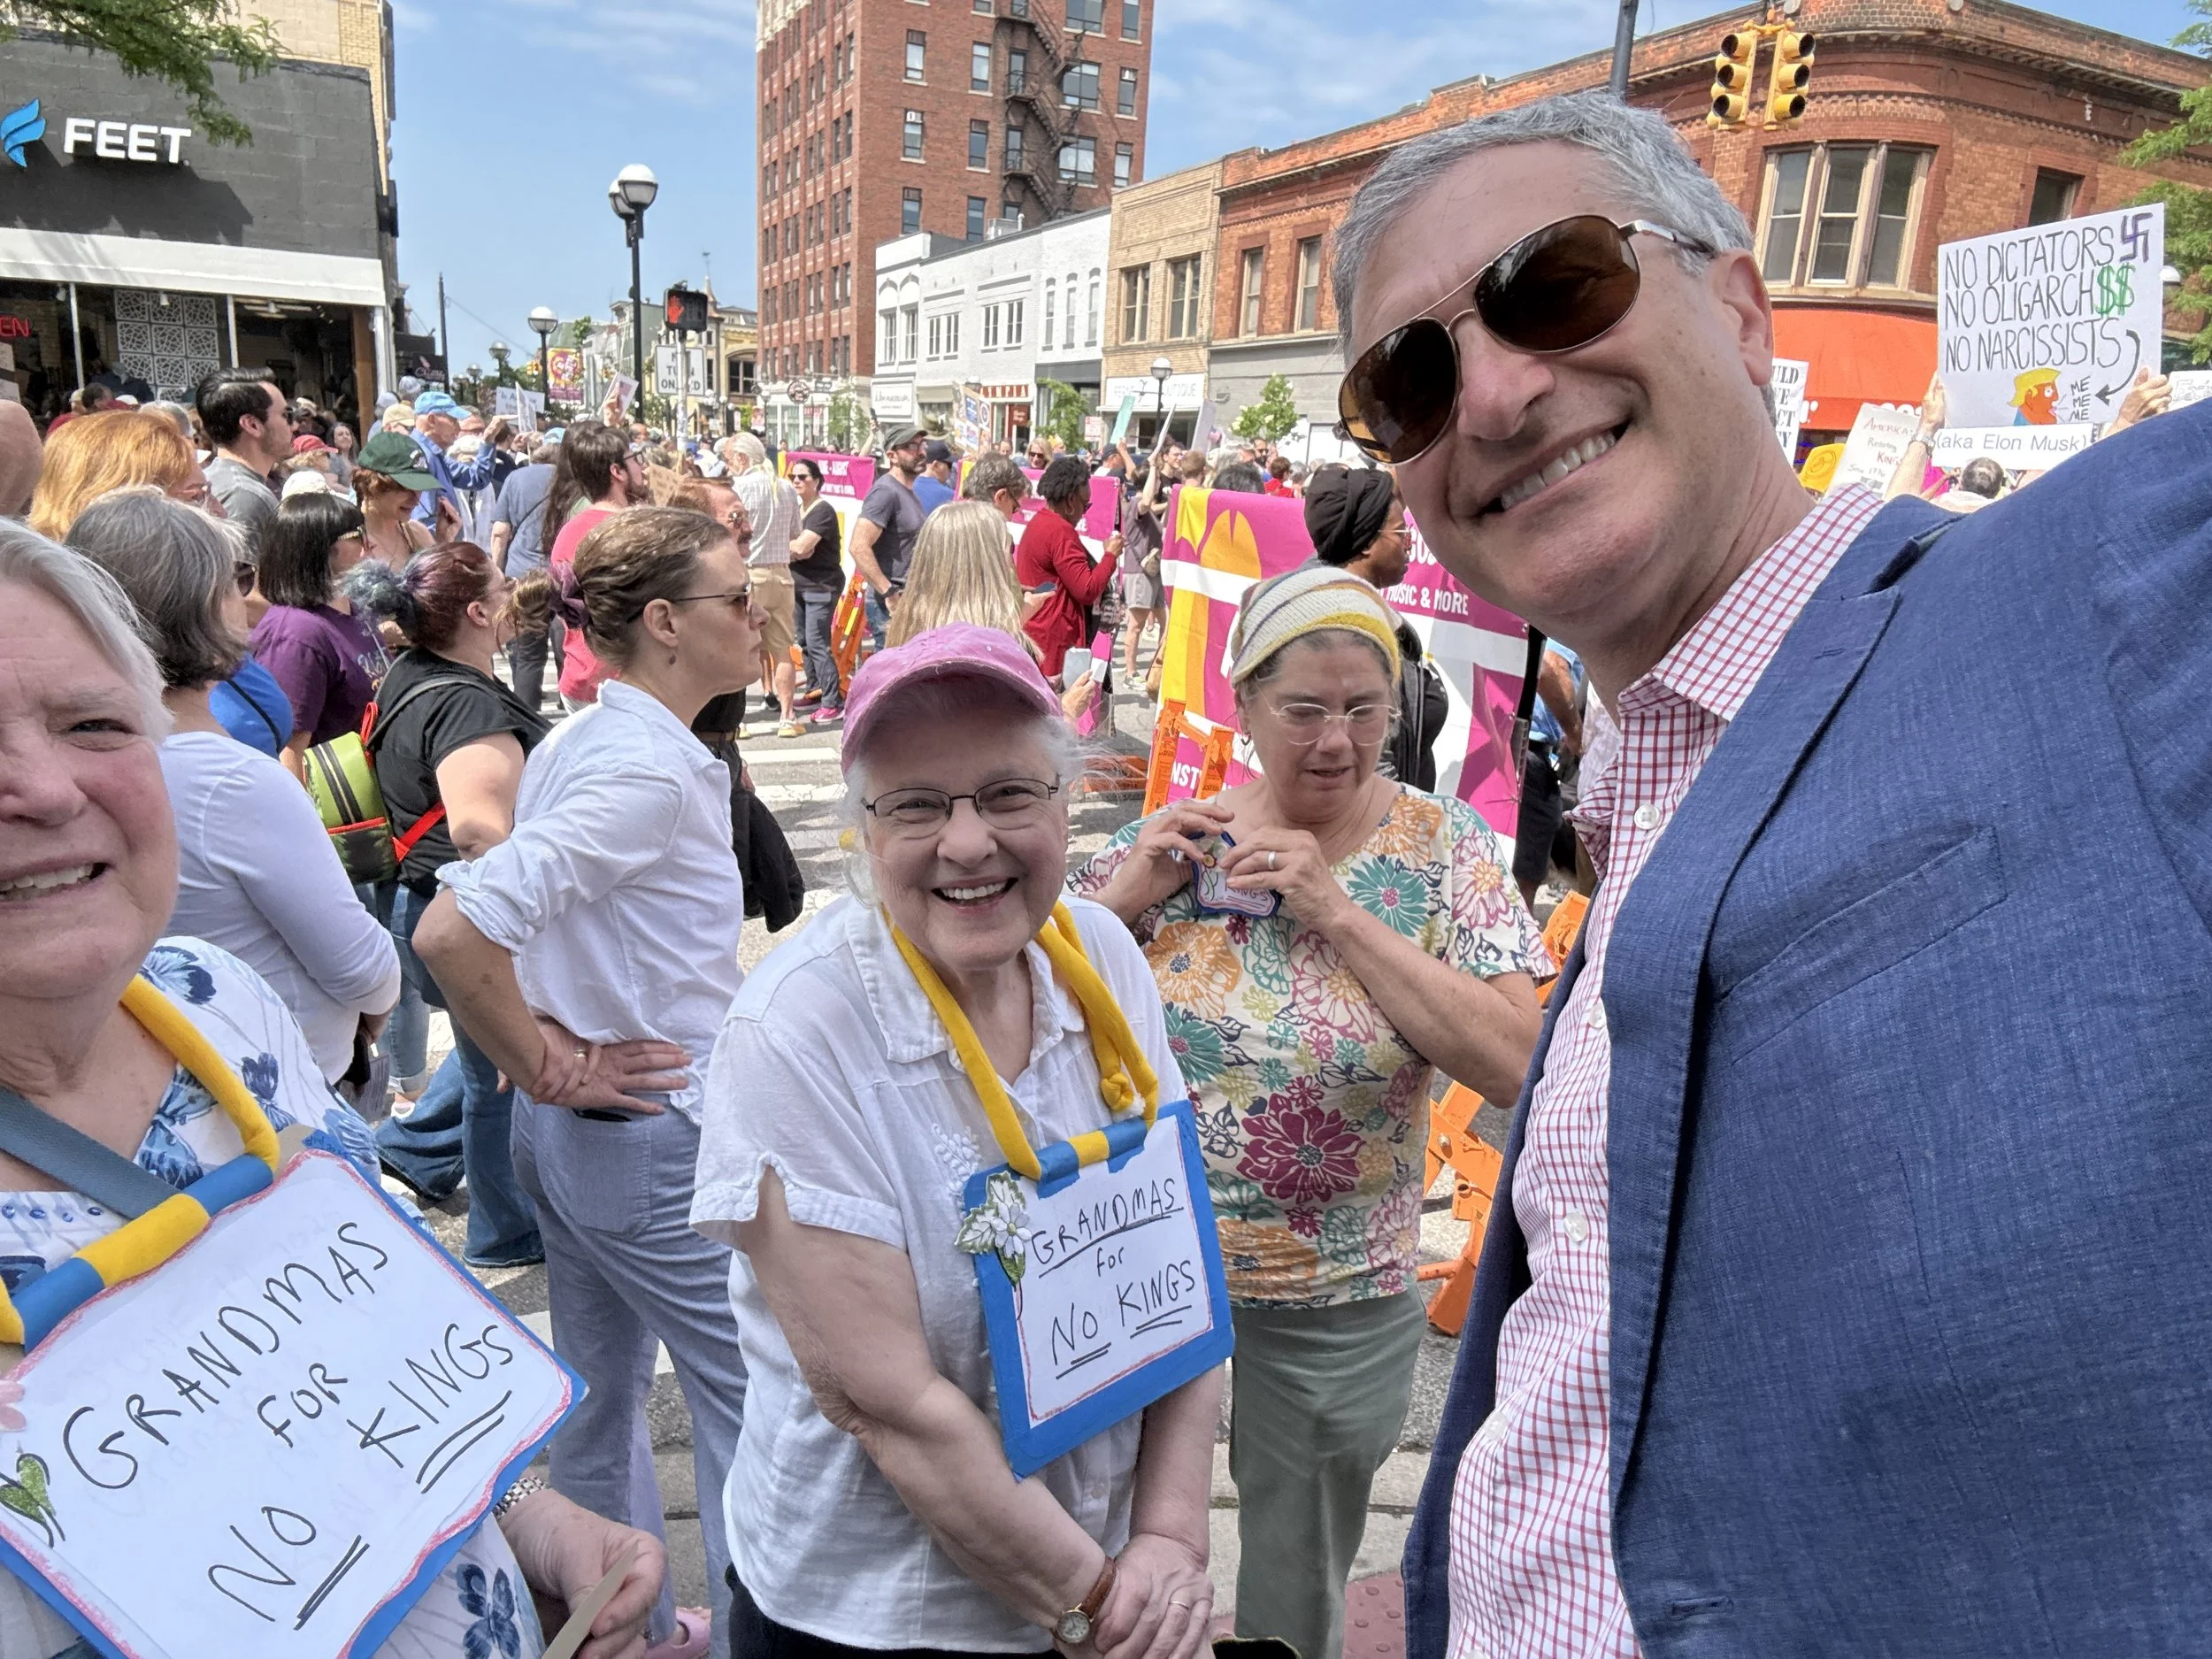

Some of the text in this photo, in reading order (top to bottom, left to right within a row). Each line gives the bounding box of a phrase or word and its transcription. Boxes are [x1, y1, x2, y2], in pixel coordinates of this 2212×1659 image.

[64, 117, 191, 165] FEET
[1946, 226, 2115, 290] NO DICTATORS
[0, 316, 30, 337] EN
[1946, 289, 1976, 330] NO
[1946, 317, 2122, 373] NO NARCISSISTS
[661, 379, 675, 389] ON
[666, 365, 695, 376] TUN
[2070, 375, 2091, 396] ME
[1164, 382, 1197, 397] OUTIQUE
[2072, 395, 2091, 408] ME
[2070, 408, 2089, 421] ME
[1936, 434, 2086, 452] (aka Elon Musk)
[1386, 584, 1469, 616] MUSIC & MORE
[1031, 1177, 1176, 1265] GRANDMAS
[1116, 1260, 1196, 1328] KINGS
[63, 1221, 388, 1489] GRANDMAS
[257, 1363, 349, 1448] FOR
[208, 1323, 513, 1623] NO KINGS
